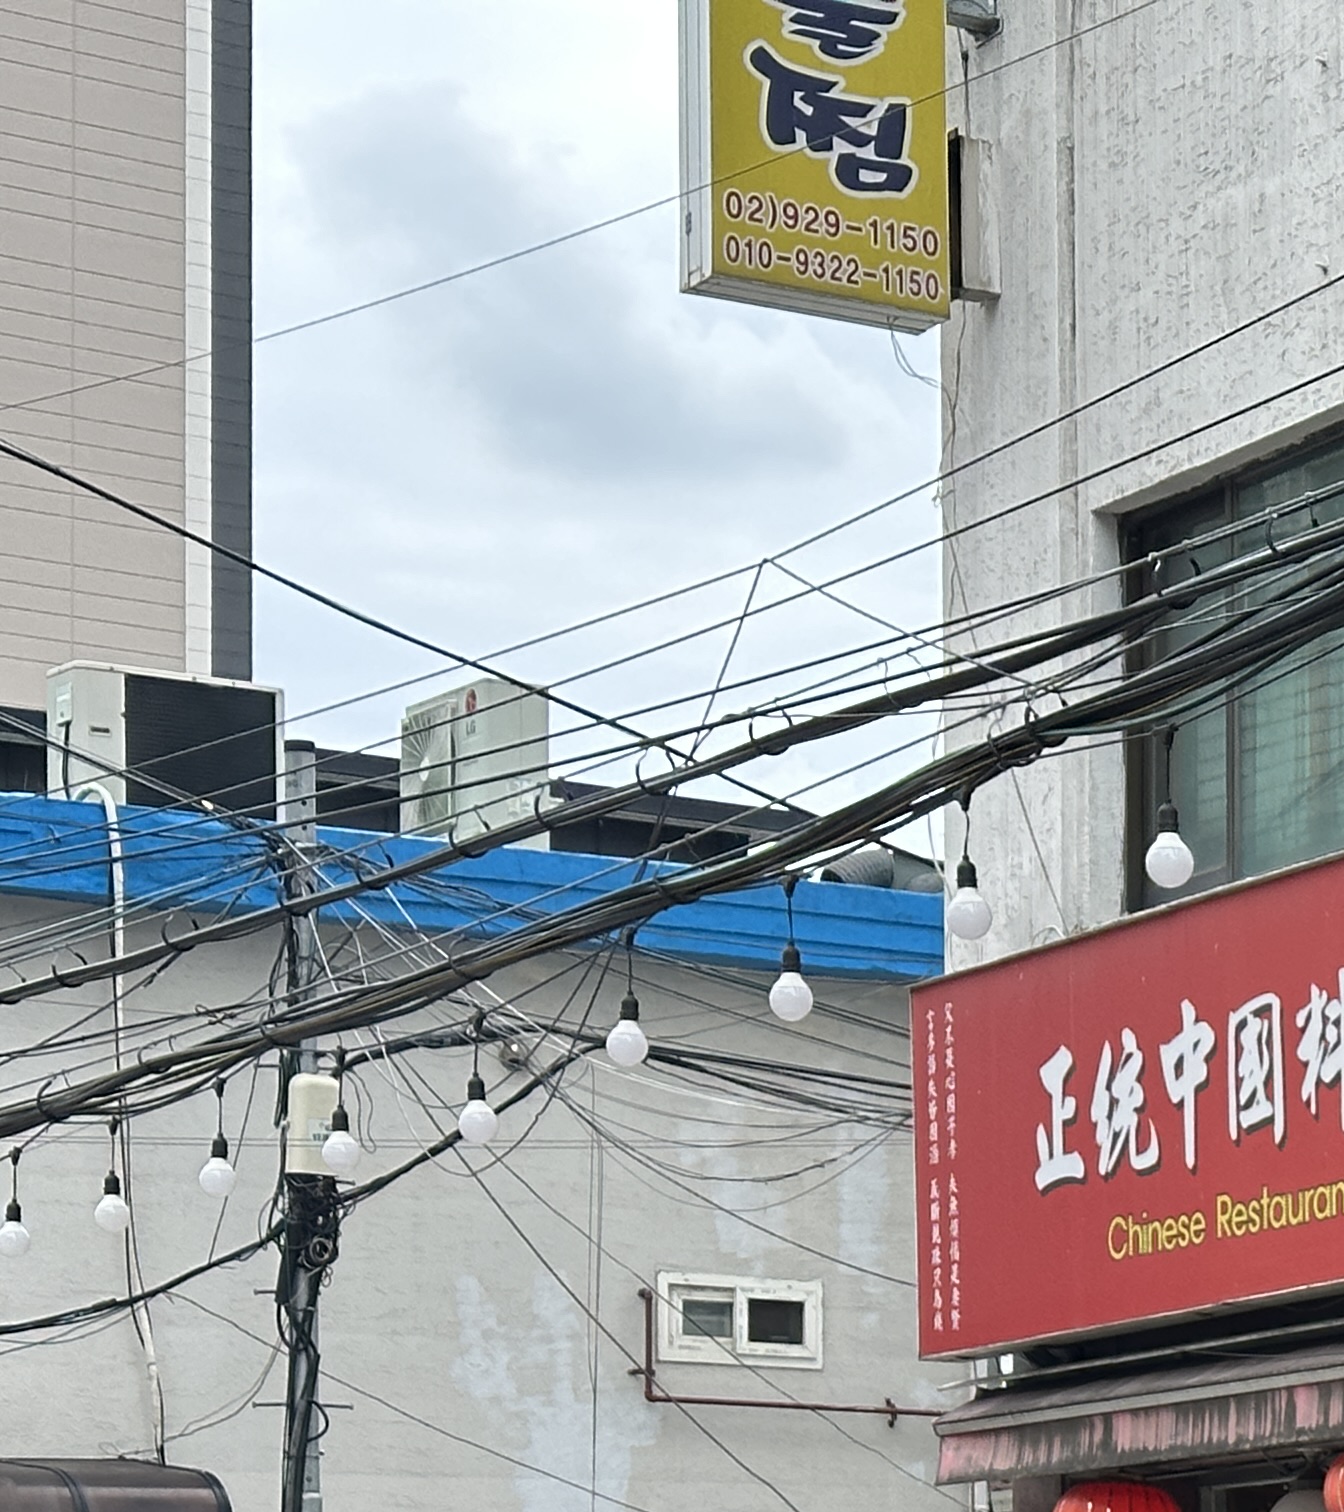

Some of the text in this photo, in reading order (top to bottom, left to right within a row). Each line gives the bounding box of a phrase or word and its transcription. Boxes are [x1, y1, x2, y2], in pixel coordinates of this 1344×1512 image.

[723, 189, 939, 258] 02)929-1150
[724, 234, 940, 301] 010-9322-1150
[1107, 1209, 1206, 1261] Chinese
